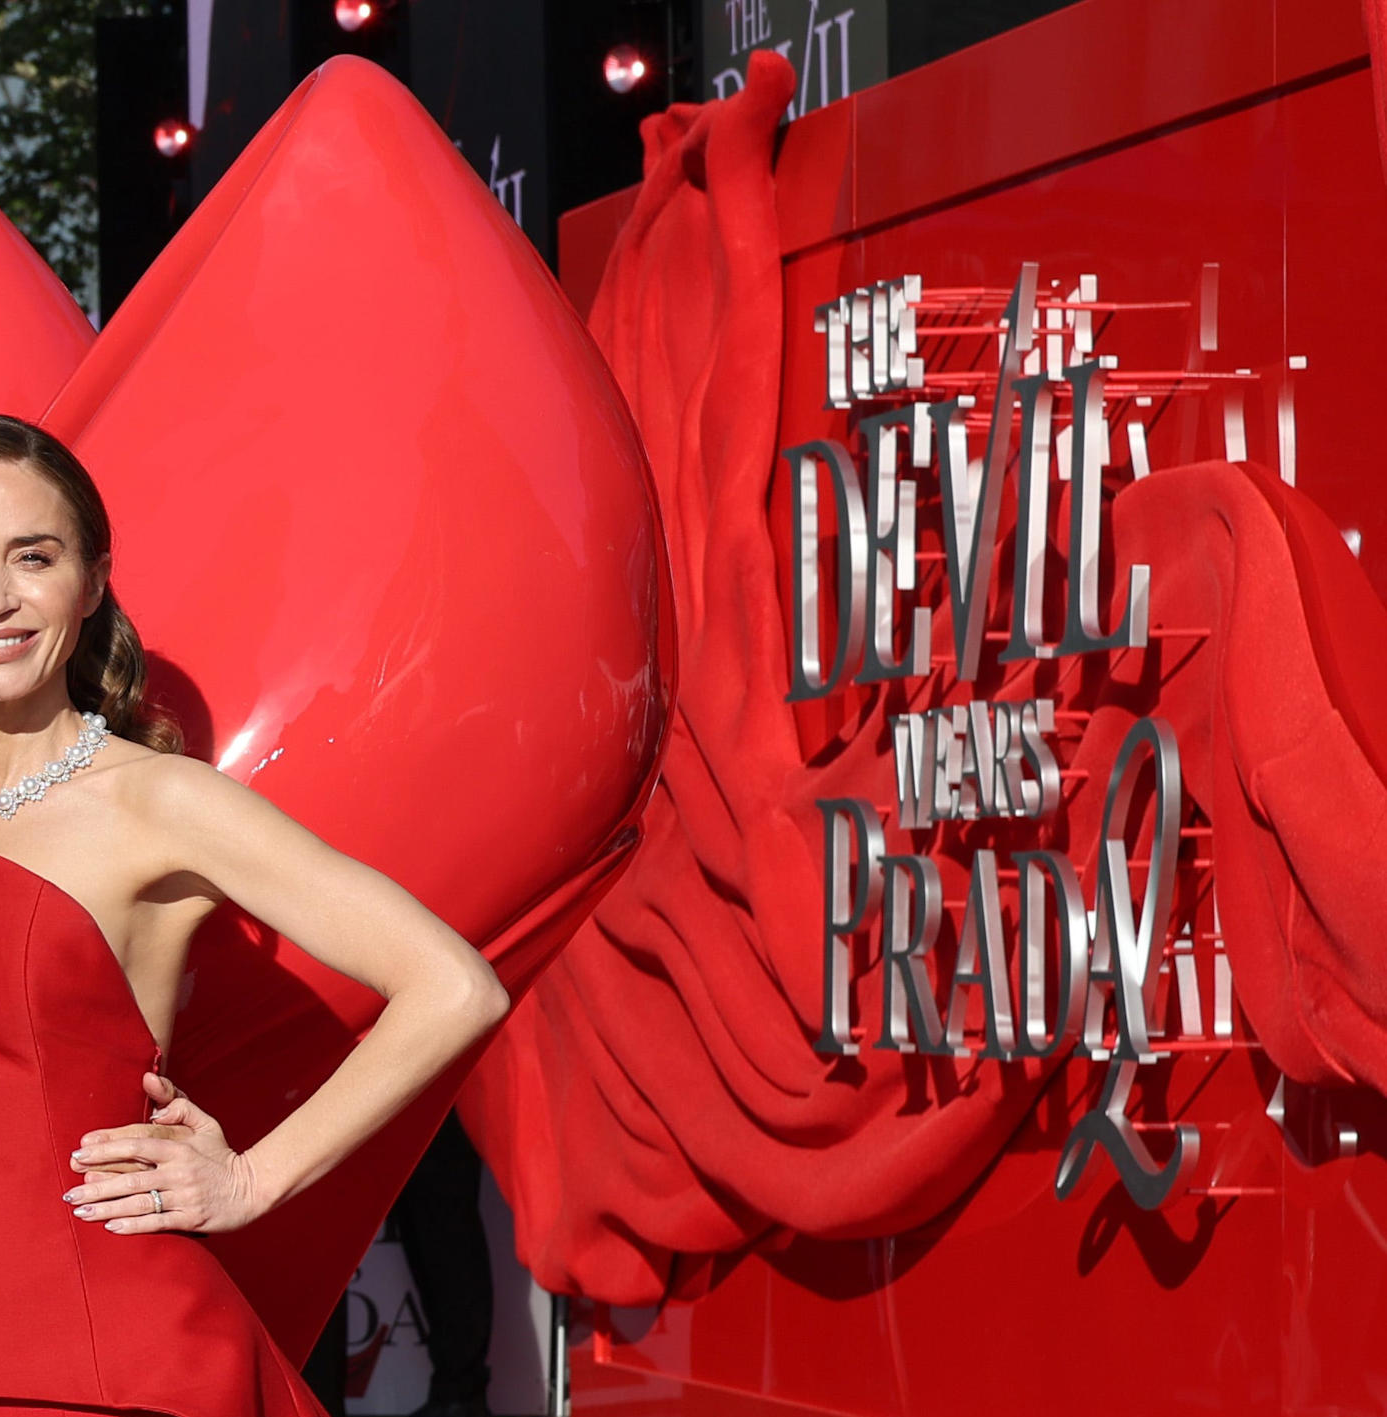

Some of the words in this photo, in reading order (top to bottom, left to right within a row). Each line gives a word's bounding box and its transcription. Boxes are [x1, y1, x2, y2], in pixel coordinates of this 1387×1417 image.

[726, 0, 772, 56] THE
[814, 274, 925, 409] THE
[781, 261, 1152, 702] DEVIL
[888, 699, 1062, 829] WEARS
[813, 797, 1157, 1065] PRADA
